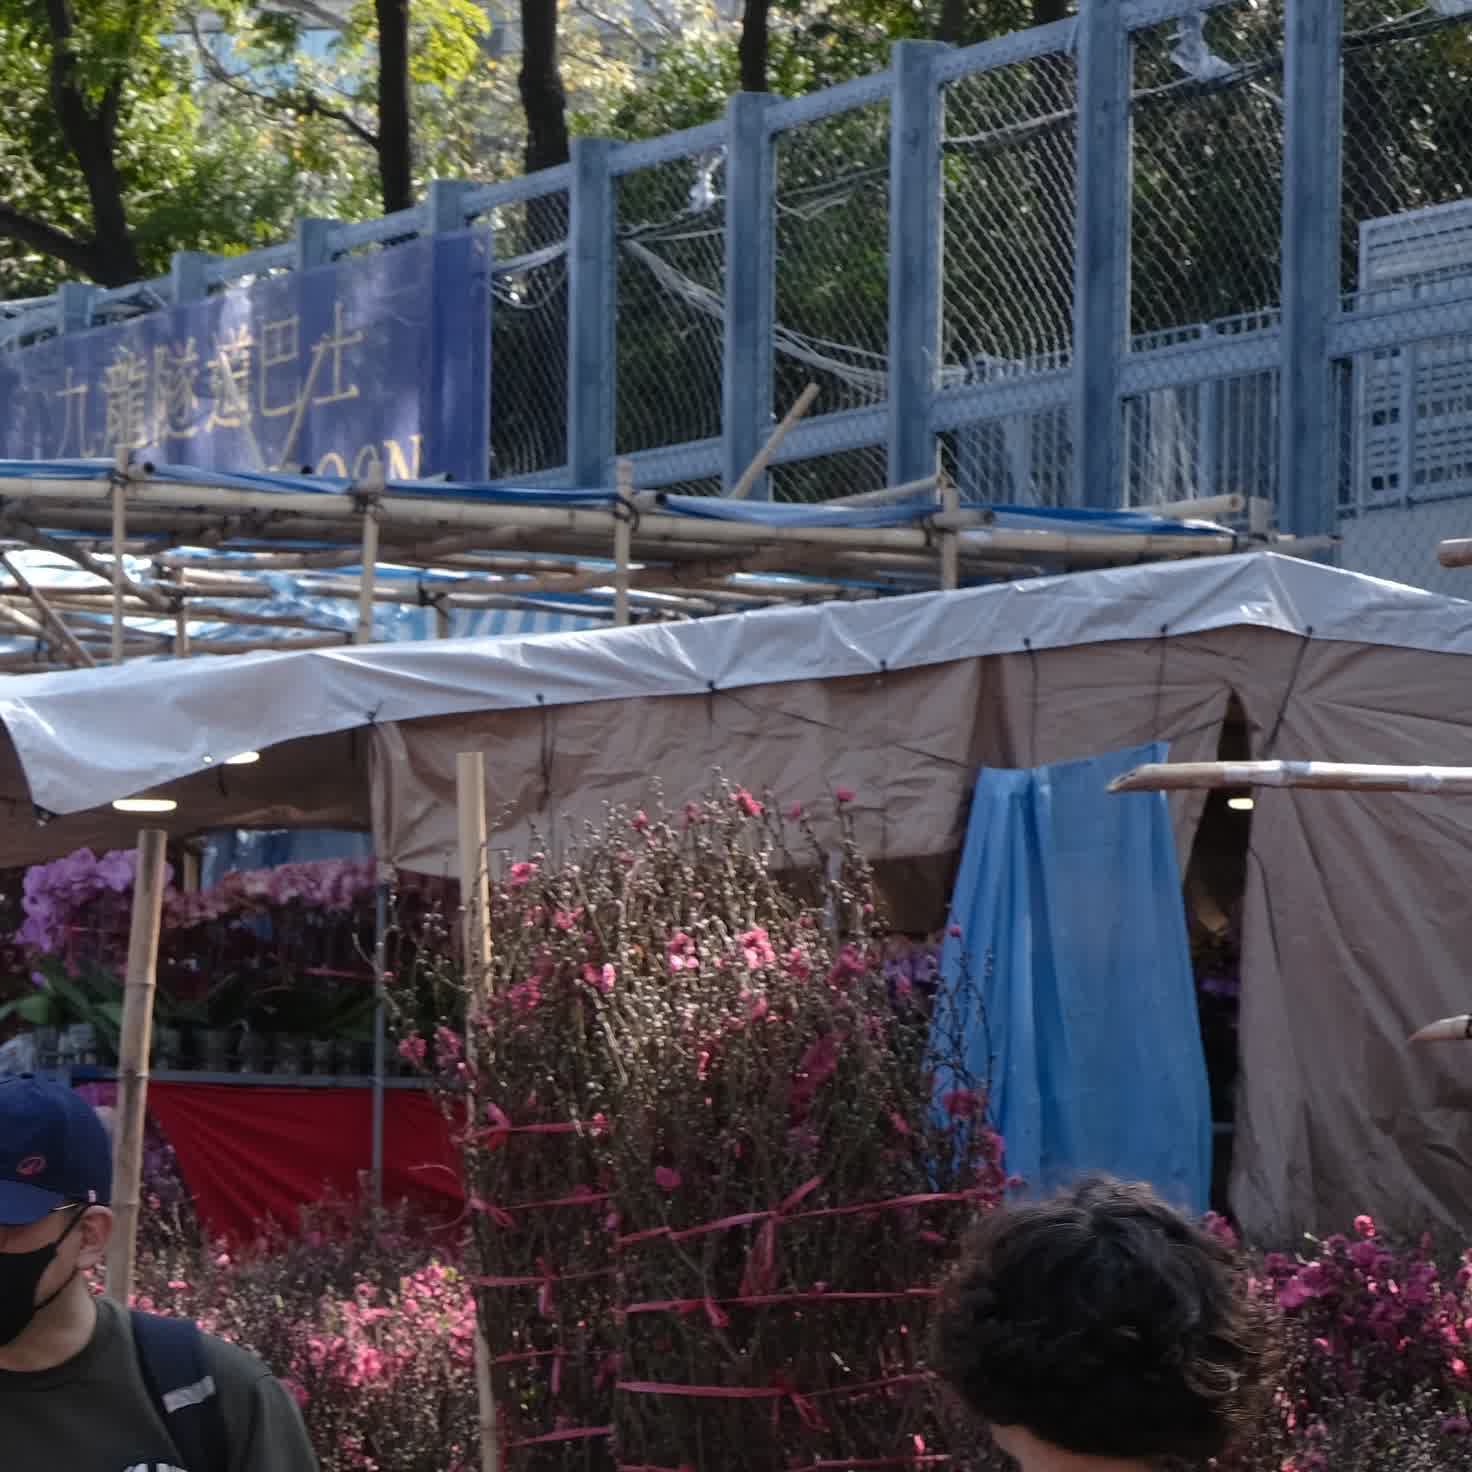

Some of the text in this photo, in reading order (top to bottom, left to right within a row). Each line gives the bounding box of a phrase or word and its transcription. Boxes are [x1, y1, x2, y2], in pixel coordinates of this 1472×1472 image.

[57, 301, 366, 459] 九龍隧道巴士
